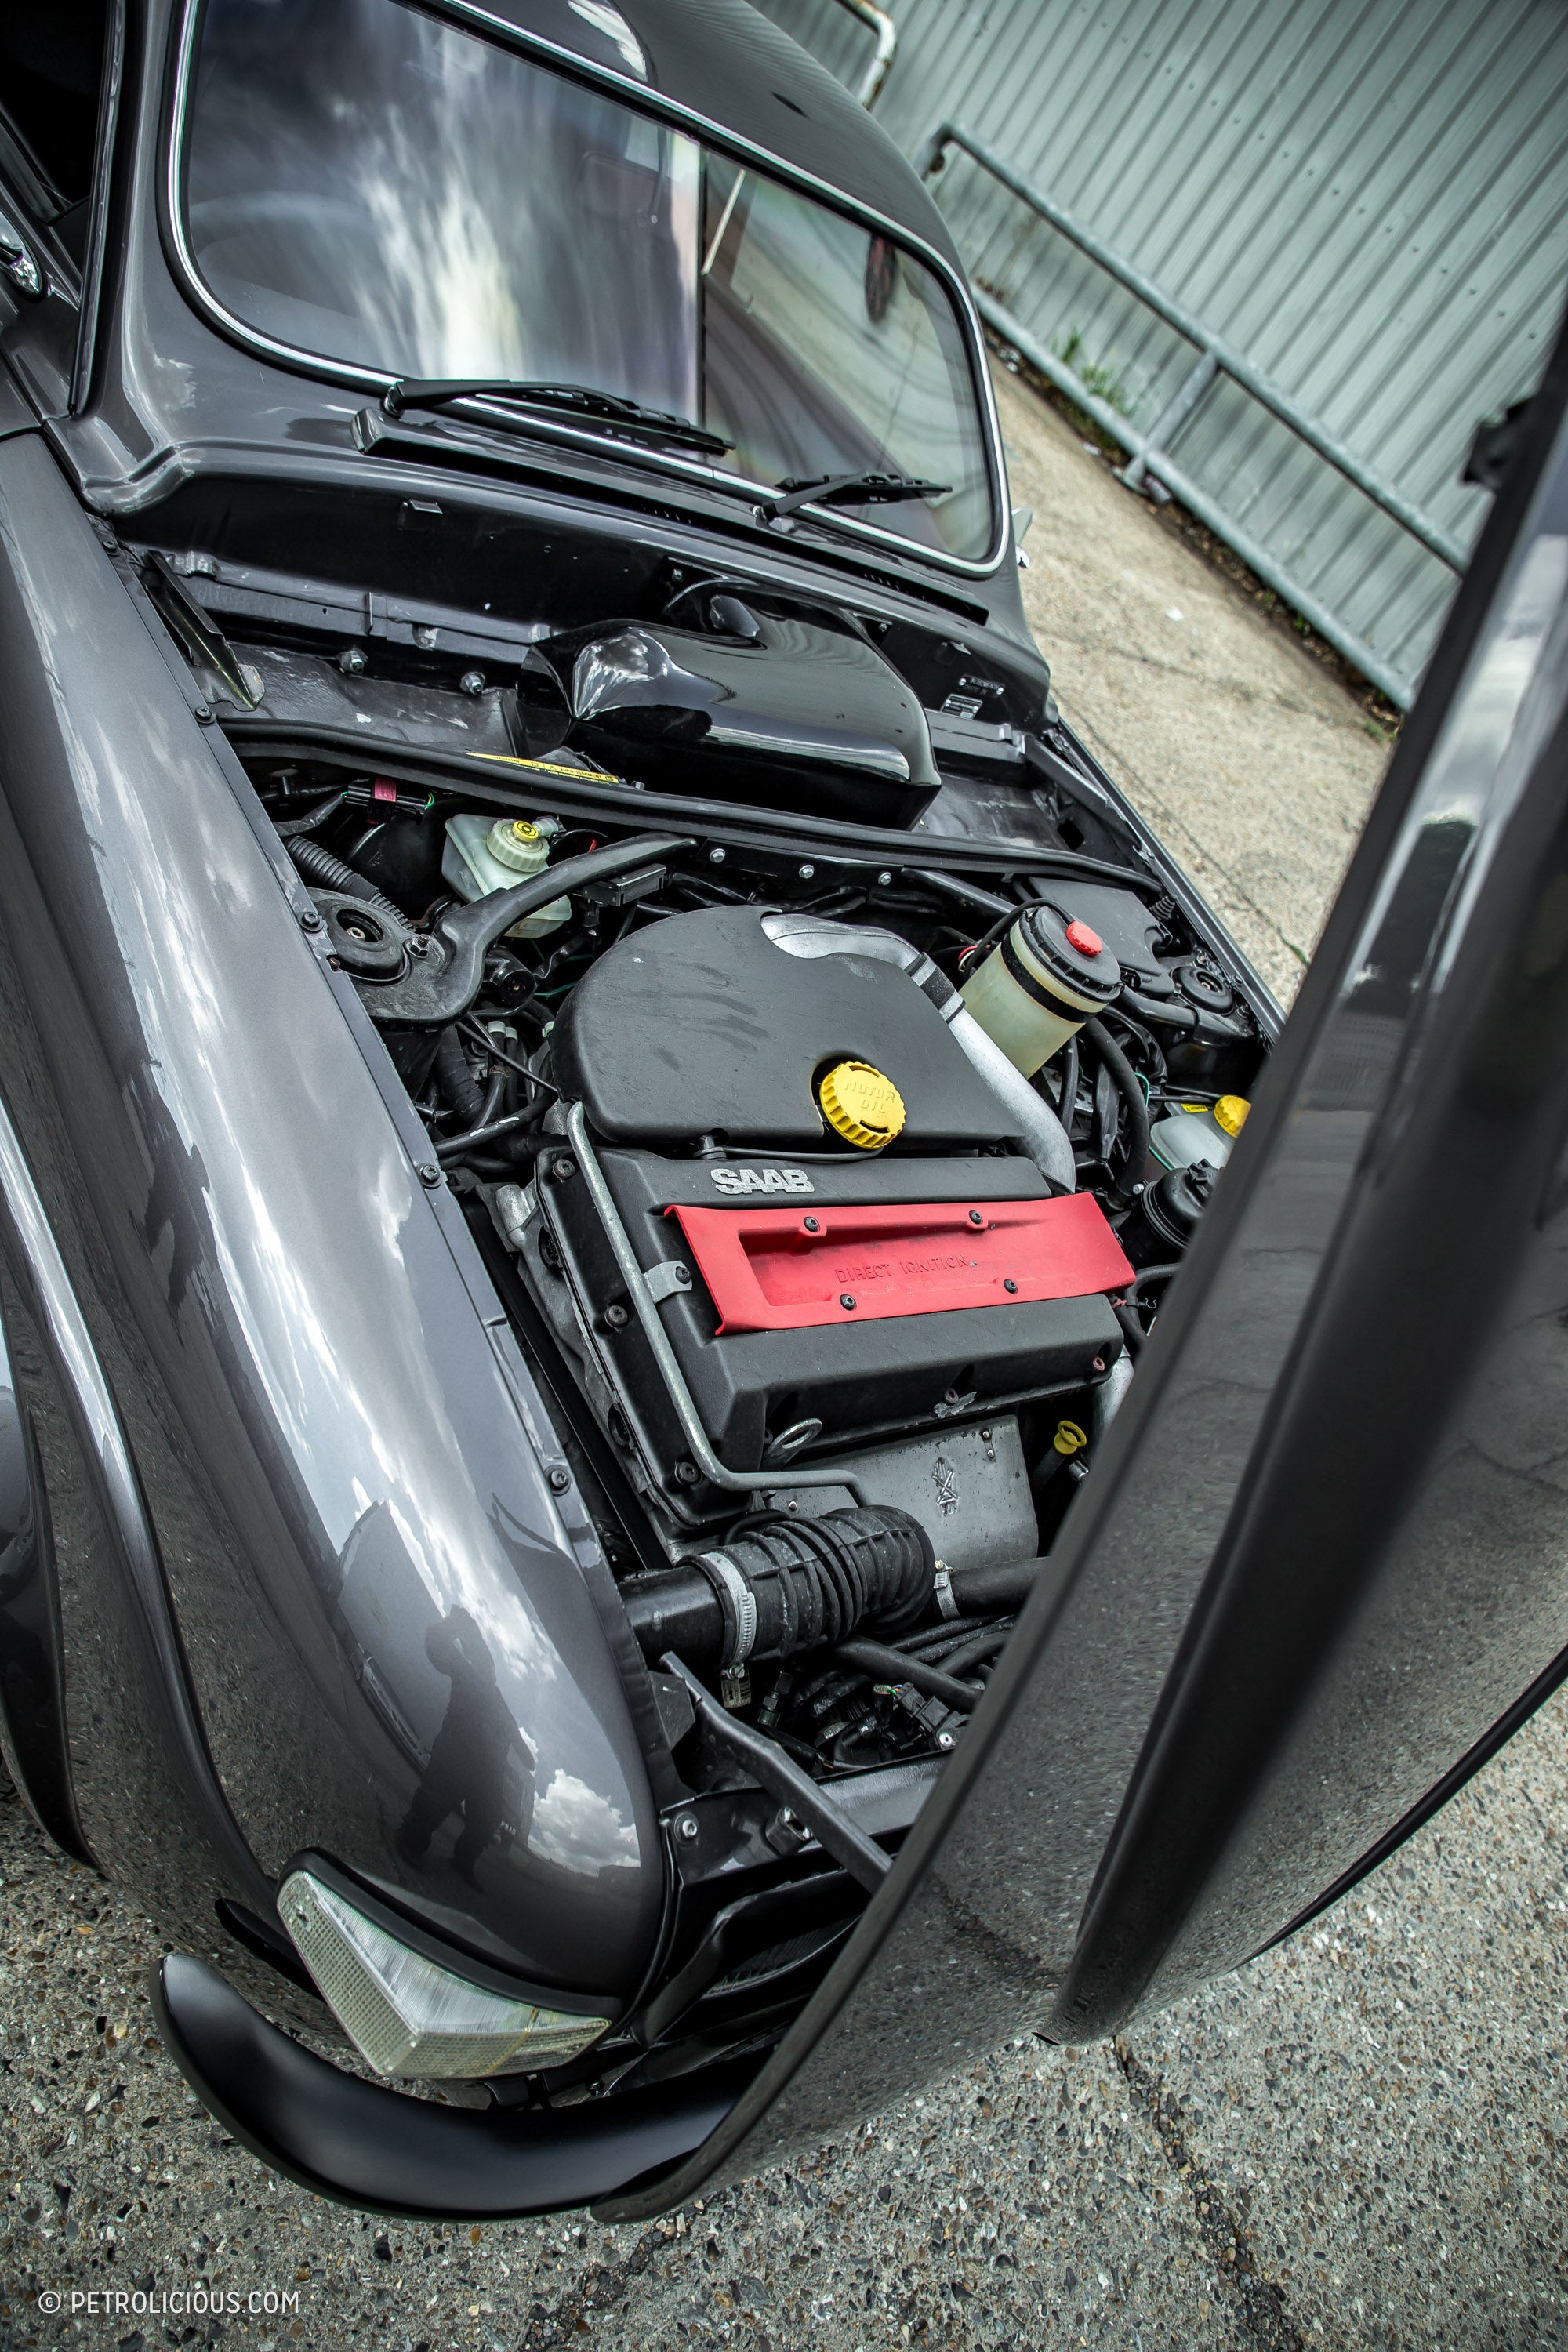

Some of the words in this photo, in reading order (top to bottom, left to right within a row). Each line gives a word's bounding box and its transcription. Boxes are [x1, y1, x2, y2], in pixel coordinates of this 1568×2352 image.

[844, 1082, 895, 1103] MOTOR
[860, 1098, 886, 1114] OIL
[710, 1168, 815, 1195] SAAB
[834, 1264, 892, 1283] DIRECT
[899, 1254, 969, 1275] IGNITION
